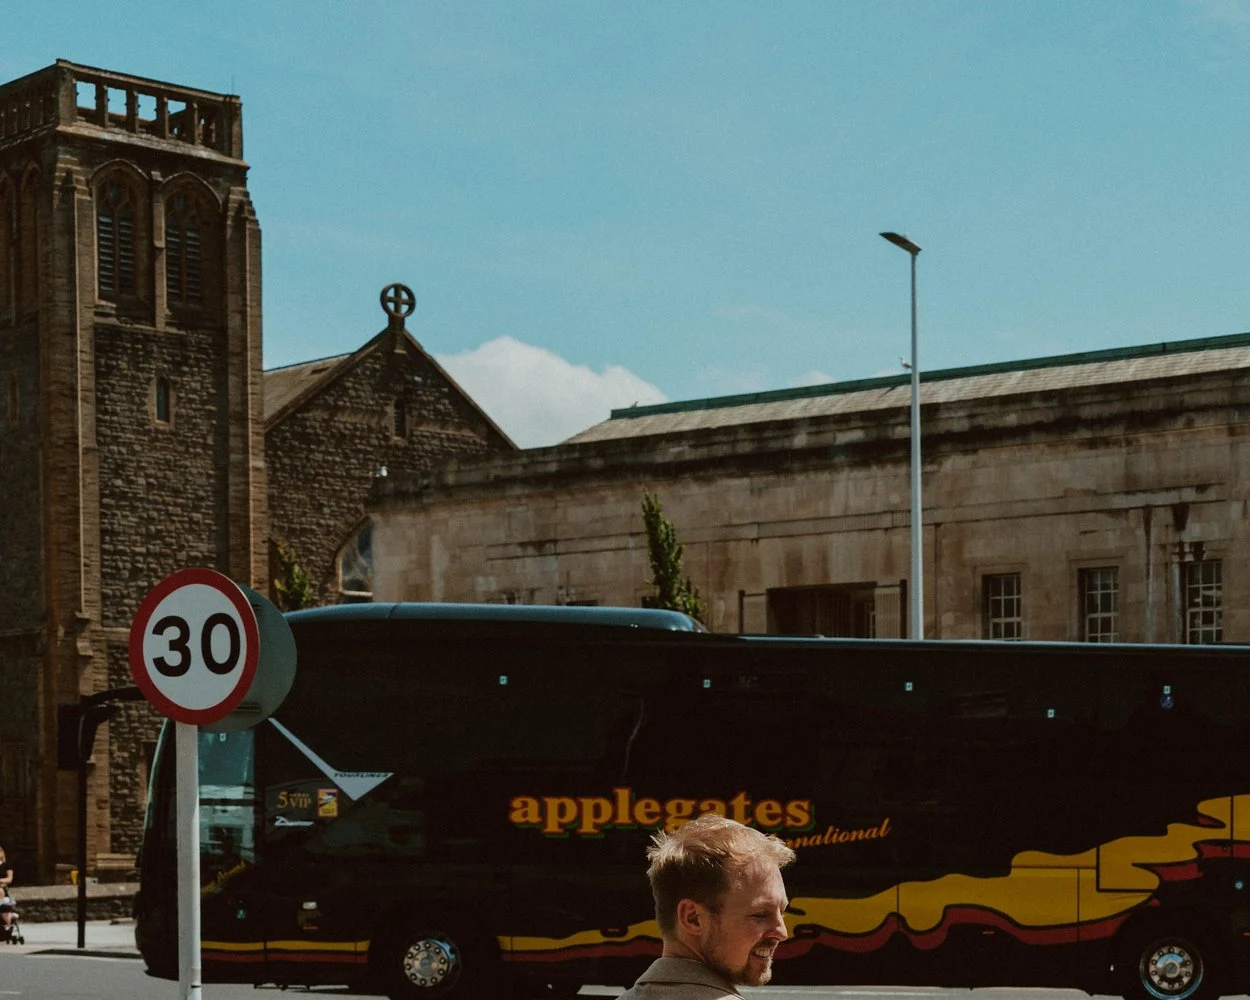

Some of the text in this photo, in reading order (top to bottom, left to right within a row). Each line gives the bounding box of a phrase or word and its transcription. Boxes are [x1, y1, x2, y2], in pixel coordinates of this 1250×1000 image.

[151, 612, 241, 678] 30
[509, 786, 815, 839] applegates
[786, 817, 892, 850] national
